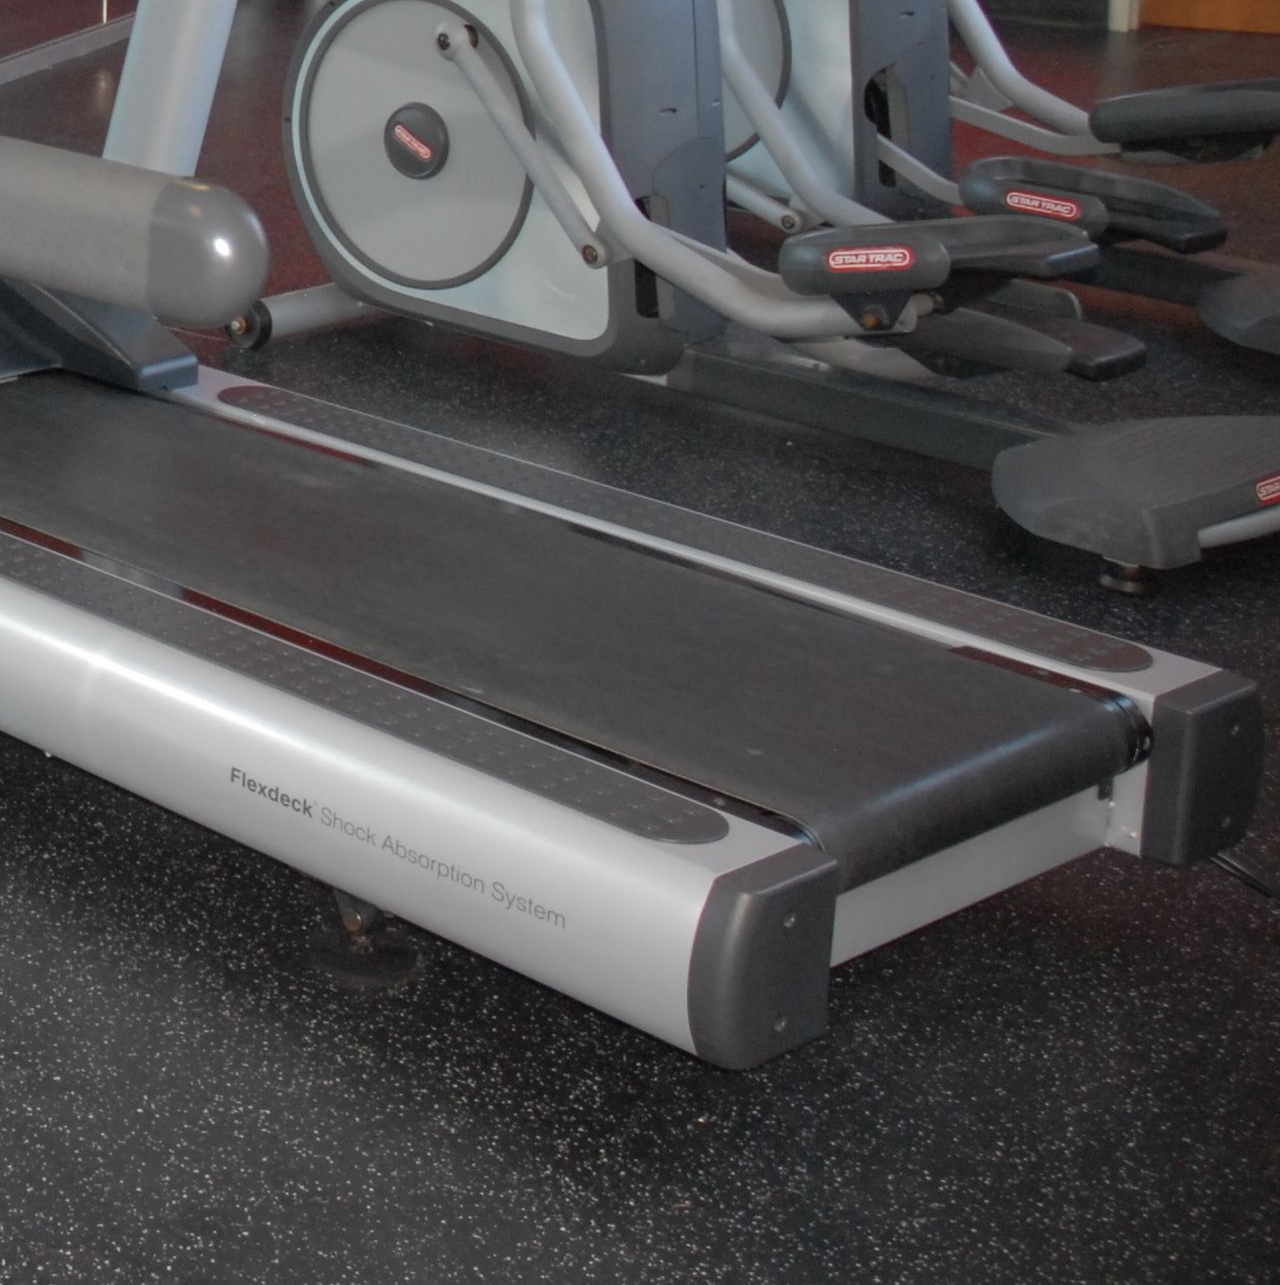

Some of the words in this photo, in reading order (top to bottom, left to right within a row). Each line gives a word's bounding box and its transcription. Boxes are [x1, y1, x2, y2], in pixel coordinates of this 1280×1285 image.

[1009, 196, 1039, 207] STAR
[1041, 202, 1071, 214] TRAC
[834, 254, 866, 264] STAR
[868, 253, 904, 263] TRAC
[230, 766, 314, 818] Flexdeck
[320, 805, 376, 847] Shock
[381, 834, 485, 894] Absorption
[491, 881, 567, 930] System
